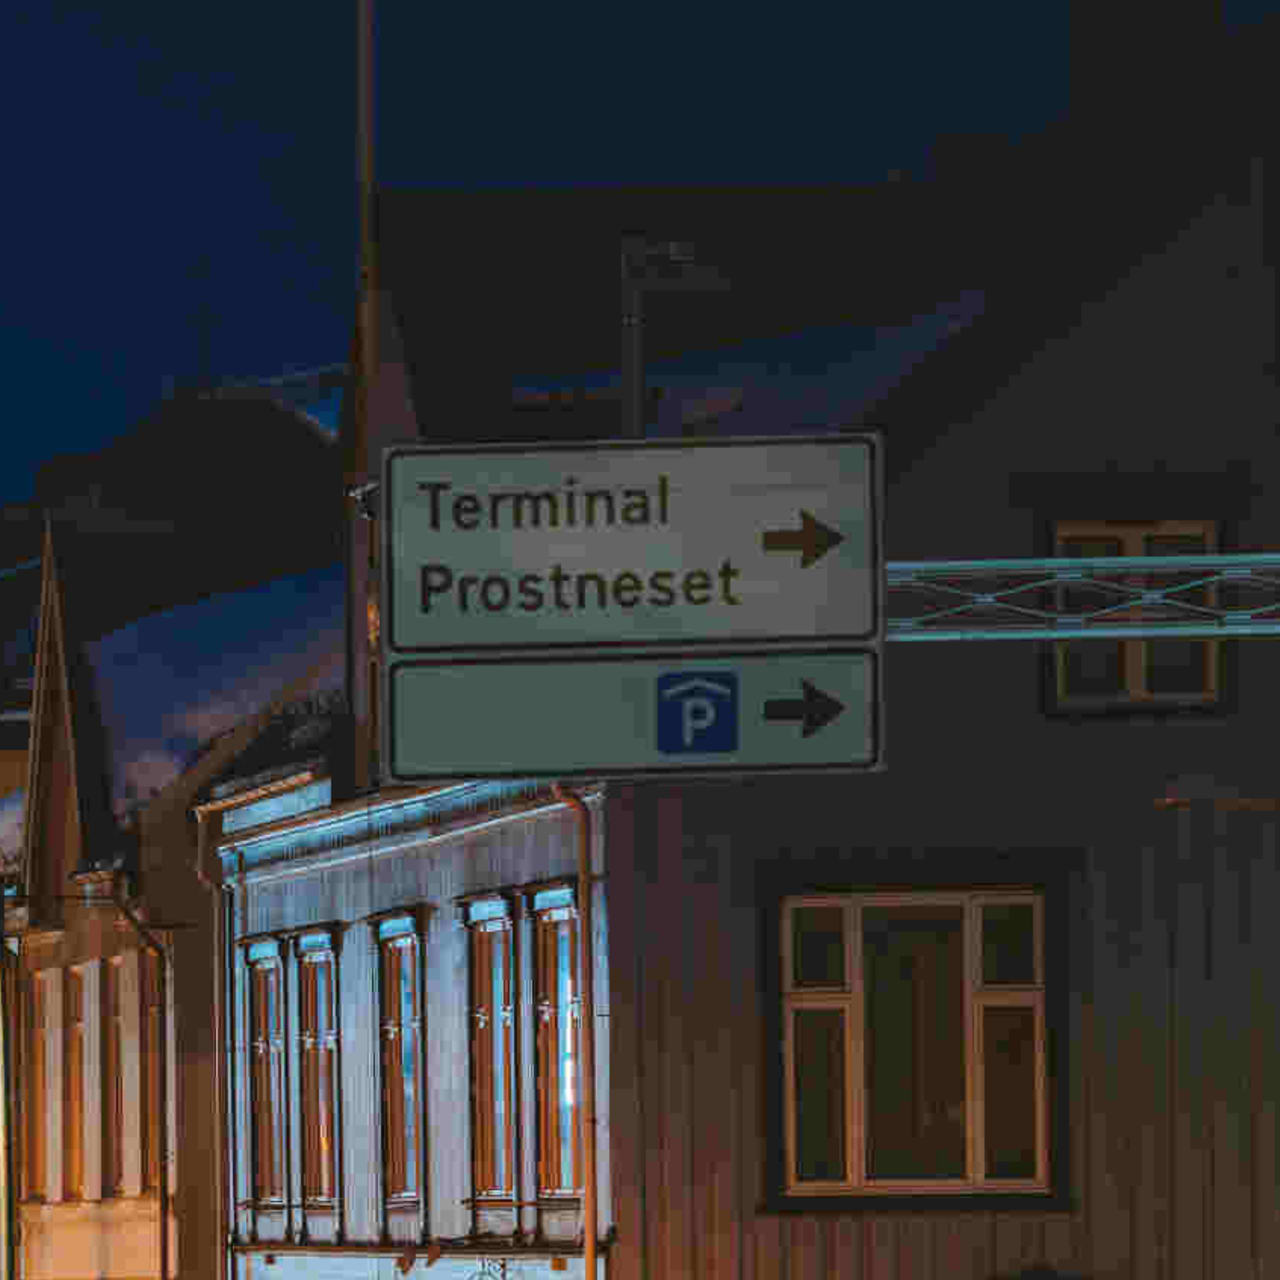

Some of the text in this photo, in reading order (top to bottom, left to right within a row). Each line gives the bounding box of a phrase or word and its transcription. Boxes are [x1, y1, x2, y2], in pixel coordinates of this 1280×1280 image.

[416, 474, 670, 531] Terminal
[418, 557, 743, 615] Prostneset
[684, 699, 716, 746] P
